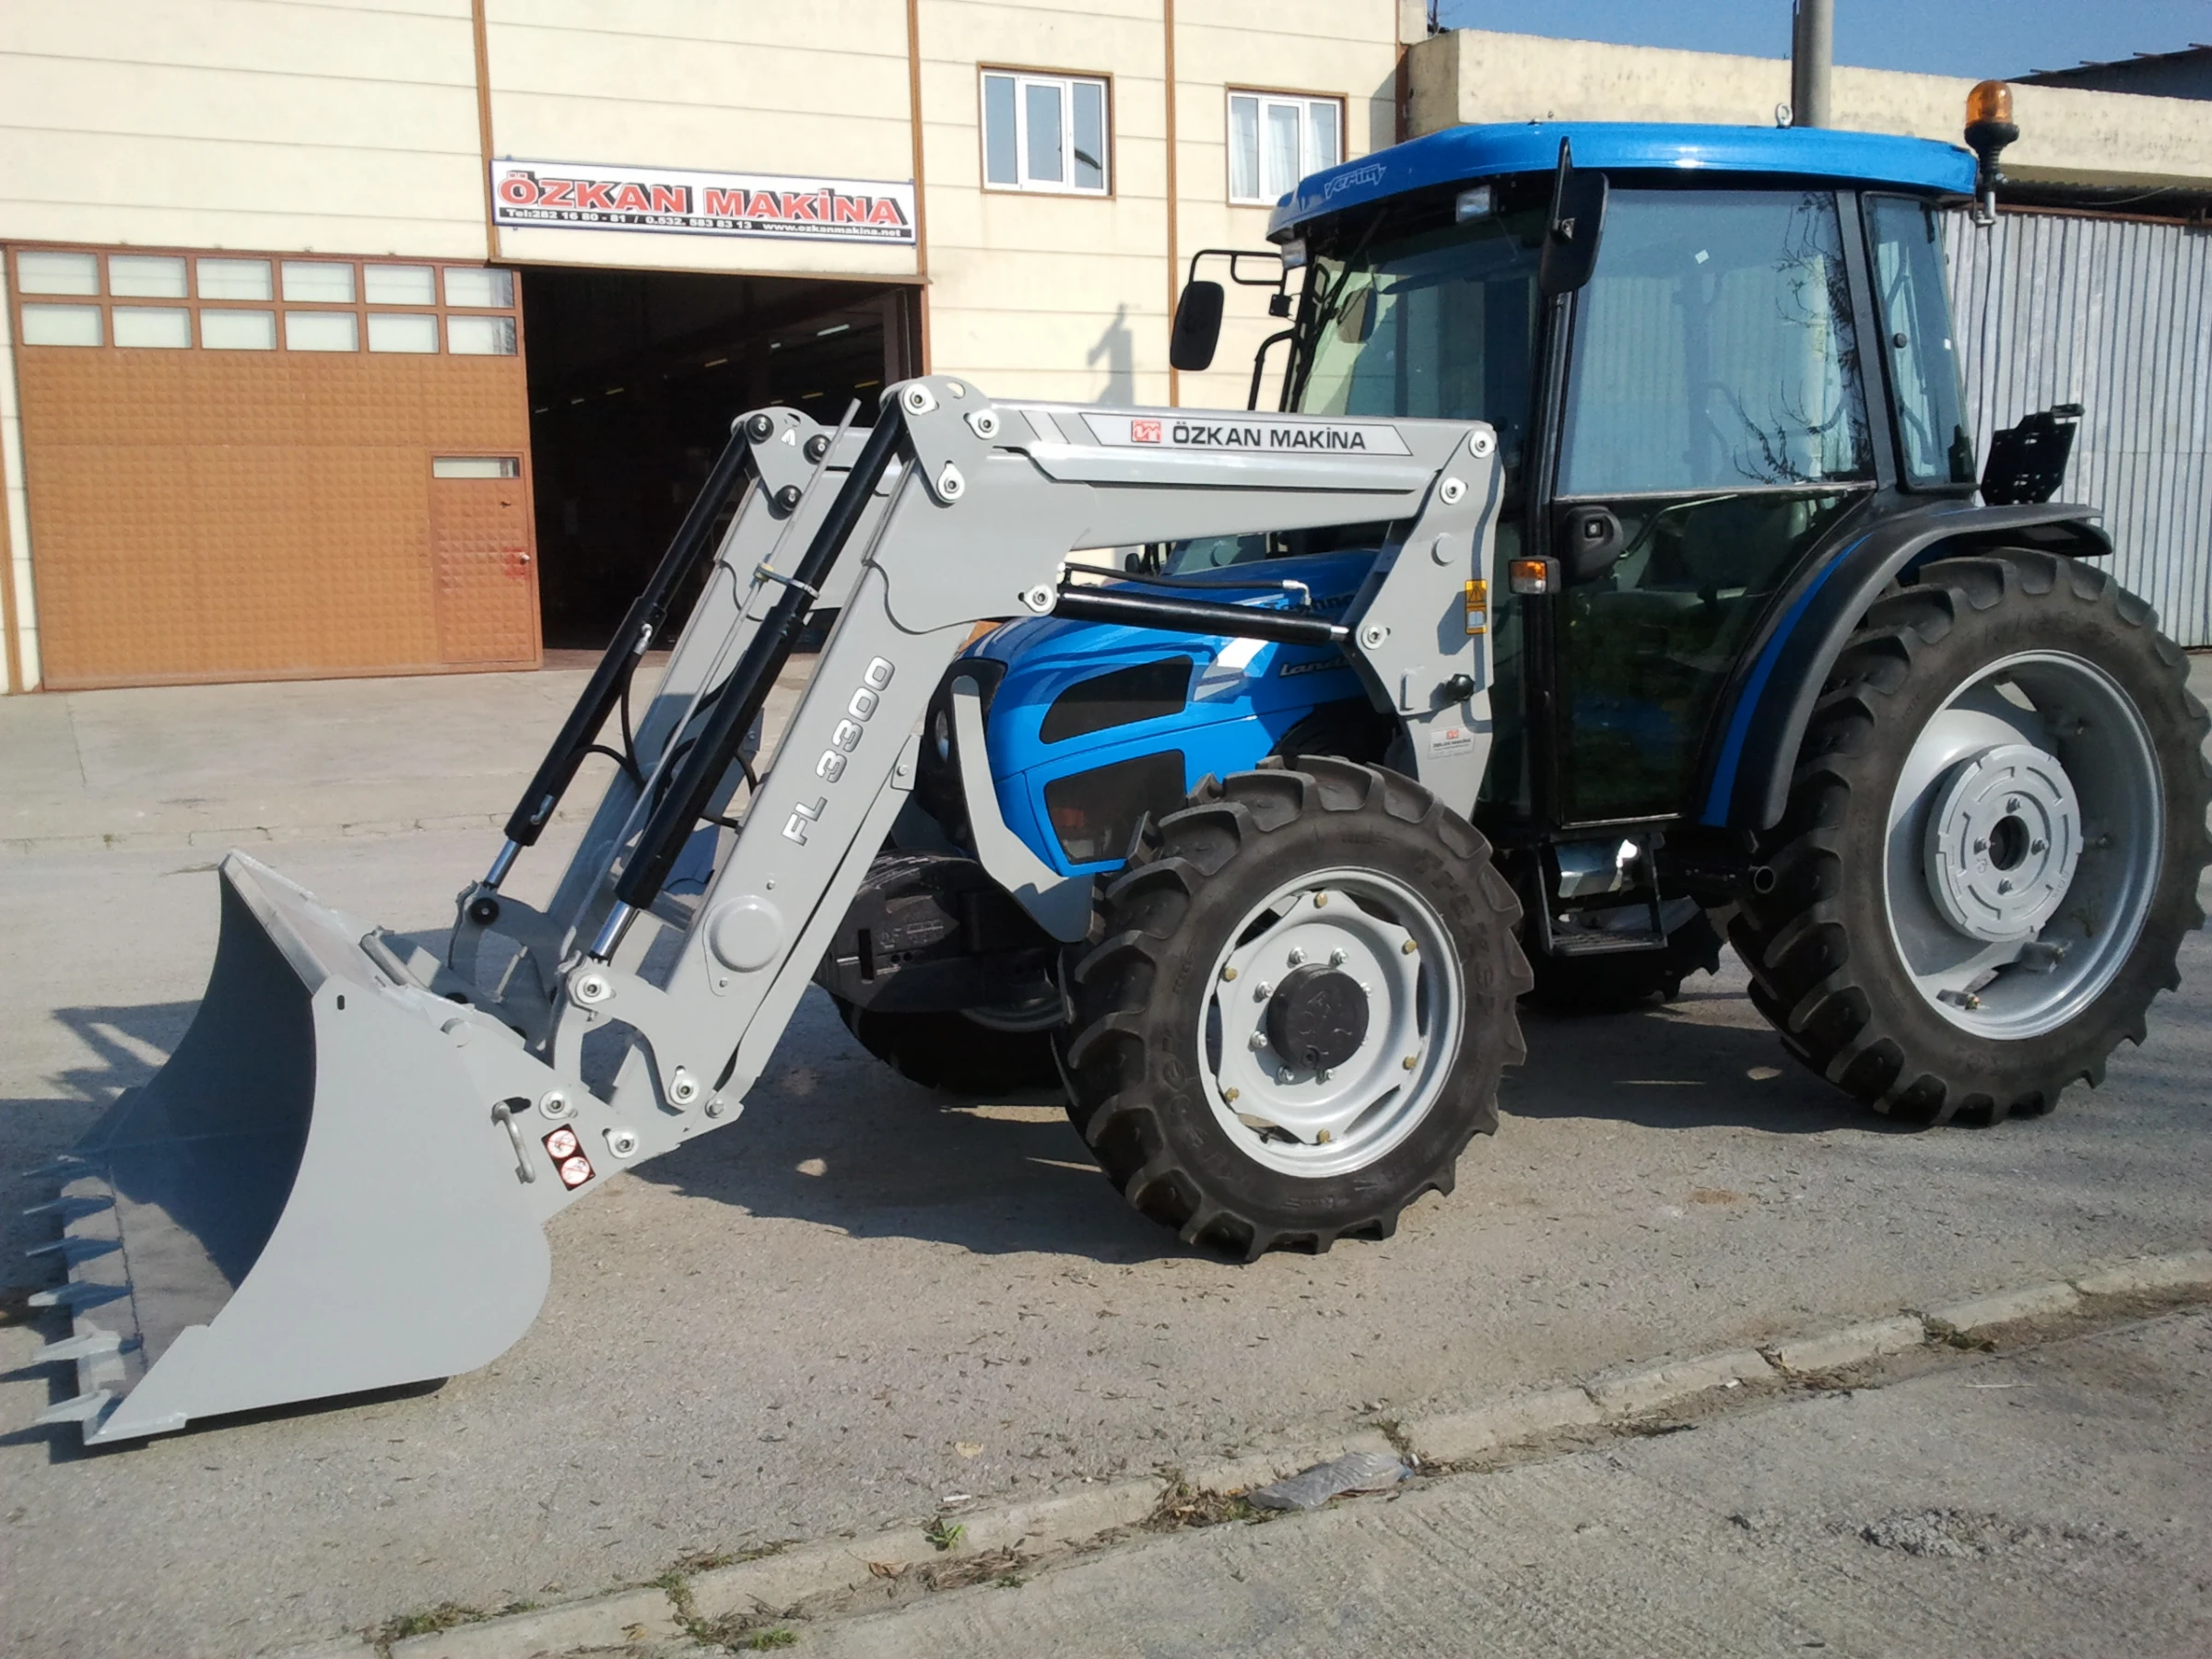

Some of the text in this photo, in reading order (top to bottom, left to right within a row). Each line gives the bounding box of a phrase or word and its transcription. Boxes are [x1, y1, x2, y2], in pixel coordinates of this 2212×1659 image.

[499, 171, 908, 225] ÖZKAN MAKİNA
[1172, 420, 1262, 447] ÖZKAN
[1269, 426, 1366, 450] MAKİNA
[782, 655, 896, 846] FL 3300
